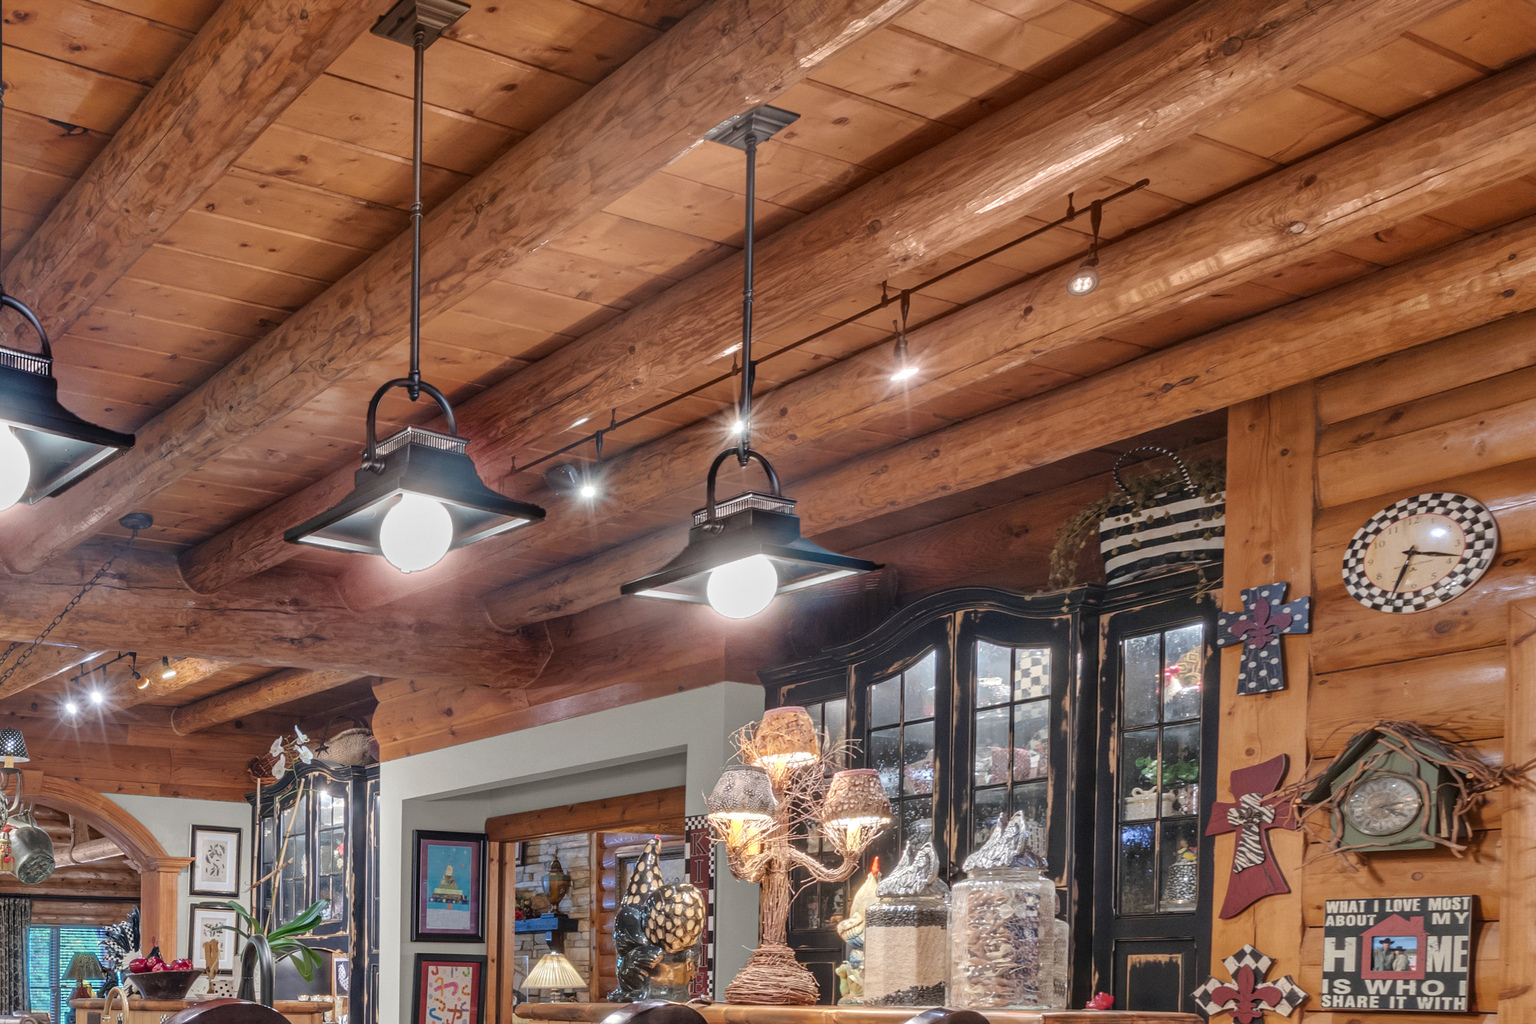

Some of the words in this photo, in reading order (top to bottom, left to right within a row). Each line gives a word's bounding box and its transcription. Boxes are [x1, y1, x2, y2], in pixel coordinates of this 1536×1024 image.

[1407, 516, 1421, 525] 12
[1388, 526, 1399, 535] 11
[1374, 540, 1386, 549] 10
[1325, 900, 1367, 914] WHAT
[1373, 899, 1379, 913] I
[1385, 898, 1421, 913] LOVE
[1428, 896, 1470, 912] MOST
[1325, 914, 1377, 927] ABOUT
[1431, 911, 1470, 925] MY
[1322, 978, 1351, 995] IS
[1364, 979, 1445, 996] WHO
[1459, 980, 1467, 996] I
[1321, 994, 1380, 1009] SHARE
[1389, 996, 1407, 1010] IT
[1417, 996, 1466, 1011] WITH
